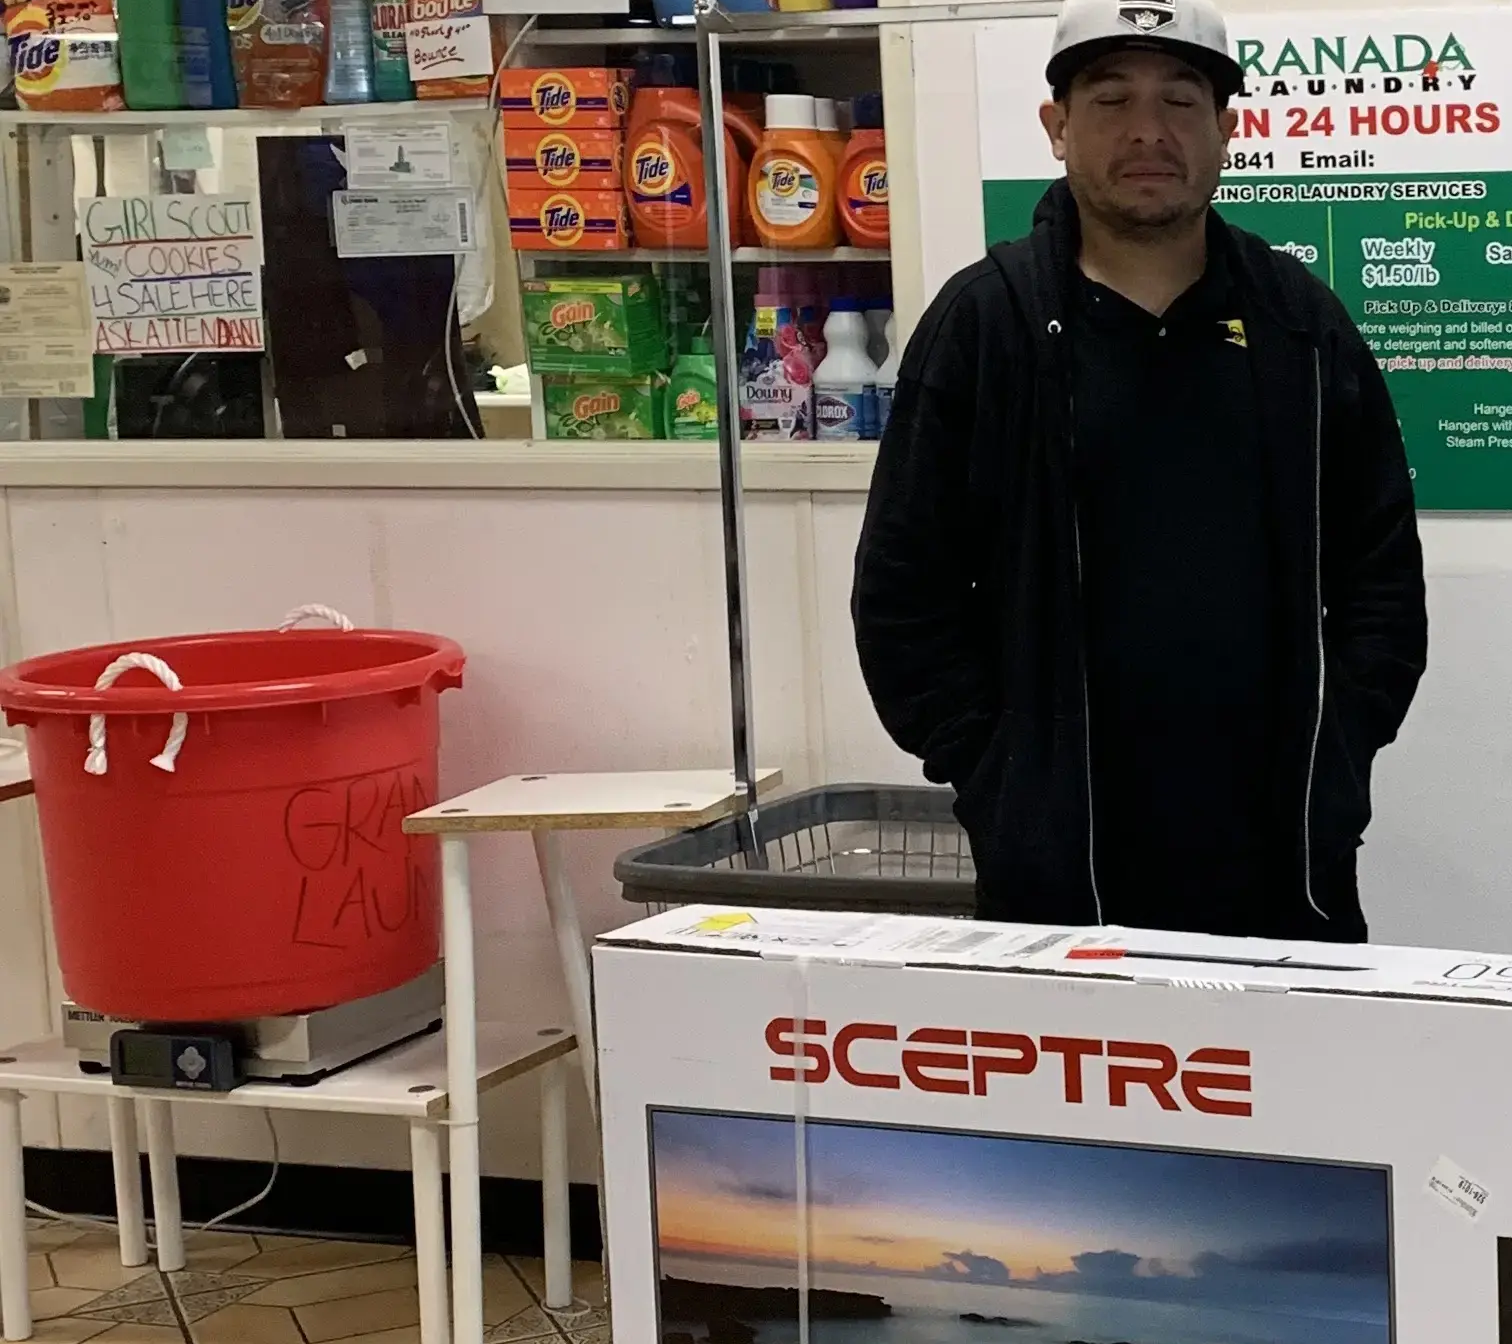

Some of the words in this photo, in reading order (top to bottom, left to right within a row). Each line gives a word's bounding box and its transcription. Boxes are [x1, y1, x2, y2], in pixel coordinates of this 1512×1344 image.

[8, 33, 61, 73] Tide
[536, 86, 571, 116] Tide
[1286, 107, 1334, 137] 24
[1350, 103, 1500, 136] HOURS
[540, 146, 576, 176] Tide
[635, 155, 669, 184] Tide
[1301, 150, 1375, 169] Email:
[771, 170, 795, 188] Tide
[1257, 185, 1296, 201] FOR
[1299, 184, 1388, 200] LAUNDRY
[1392, 182, 1485, 199] SERVICES
[86, 197, 157, 245] GIRL
[166, 200, 251, 240] SCOUT
[544, 206, 580, 236] Tide
[1406, 212, 1479, 232] Pick-Up
[1486, 211, 1499, 228] &
[124, 243, 242, 278] COOKIES
[1362, 238, 1434, 262] Weekly
[1363, 265, 1439, 287] $1.50/lb
[92, 284, 115, 317] 4
[117, 280, 189, 315] SALE
[190, 279, 256, 310] HERE
[1365, 301, 1396, 313] Pick
[1401, 301, 1420, 315] Up
[1425, 301, 1436, 312] &
[1441, 301, 1505, 314] Delivery:
[552, 301, 595, 328] Gain
[97, 320, 142, 351] ASK
[146, 316, 262, 350] ATTENDANT
[573, 393, 620, 421] Gain
[677, 388, 701, 410] Gain
[746, 385, 793, 406] Downy
[765, 1016, 1252, 1117] SCEPTRE
